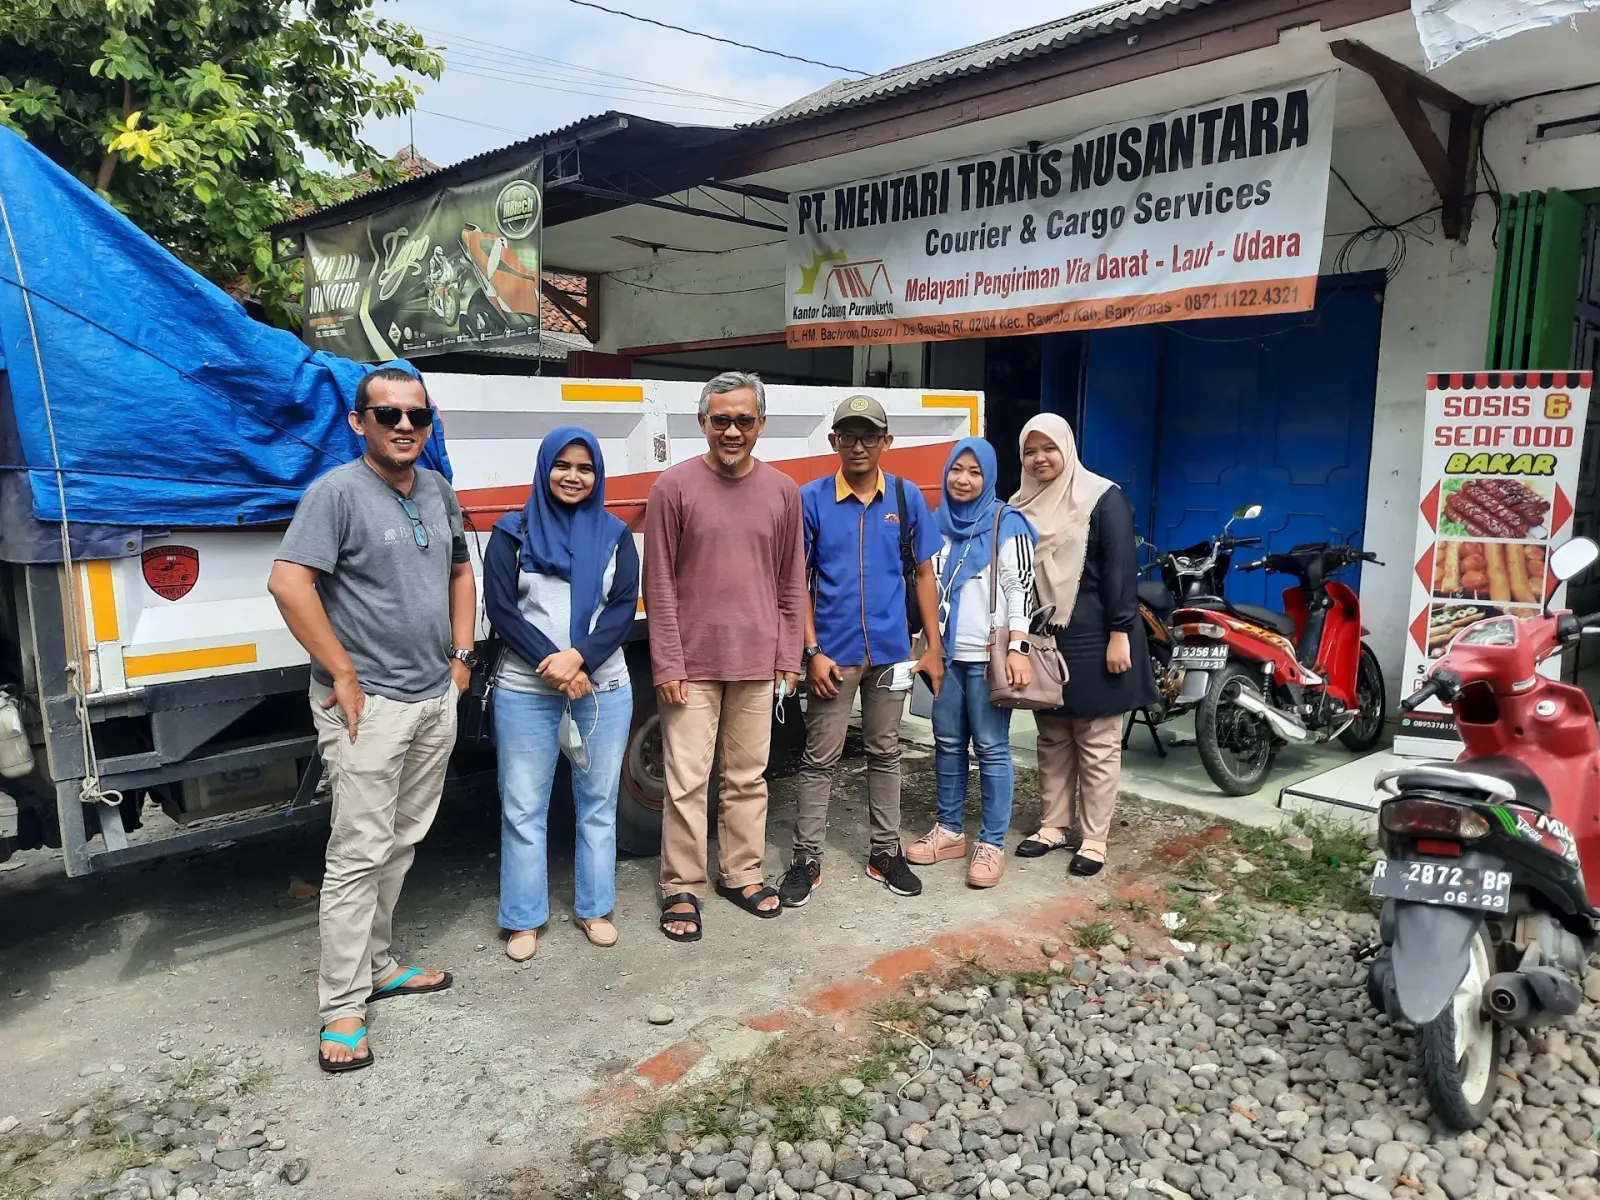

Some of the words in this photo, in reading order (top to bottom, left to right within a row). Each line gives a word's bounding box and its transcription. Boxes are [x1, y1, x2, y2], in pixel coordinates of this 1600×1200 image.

[798, 191, 828, 236] PT.
[833, 168, 951, 232] MENTARI
[957, 149, 1063, 212] TRANS
[1069, 88, 1310, 193] NUSANTARA
[503, 196, 533, 219] MBtech
[925, 222, 1012, 257] Courier
[1019, 214, 1037, 245] &
[1046, 204, 1126, 239] Cargo
[1133, 179, 1273, 225] Services
[904, 271, 970, 305] Melayani
[973, 265, 1060, 299] Pengiriman
[1065, 257, 1092, 285] Via
[1096, 249, 1149, 281] Darat
[1171, 240, 1215, 274] Laut
[1232, 229, 1301, 263] Udara
[792, 305, 820, 321] Kantor
[821, 303, 847, 320] Cabang
[848, 300, 894, 317] Purwokerto
[801, 328, 818, 341] HM.
[860, 325, 892, 339] Dusun
[917, 320, 951, 336] Rawalo
[968, 316, 997, 332] 02/04
[999, 314, 1025, 330] Kec.
[1026, 311, 1070, 329] Rawalo
[1104, 300, 1173, 321] Banyumas
[1183, 285, 1301, 313] 0821.1122.4321
[1443, 395, 1531, 418] SOSIS
[1543, 392, 1573, 420] &
[1434, 425, 1574, 448] SEAFOOD
[1444, 452, 1558, 476] BAKAR
[1172, 646, 1180, 658] B
[1210, 646, 1228, 658] AH
[1373, 859, 1388, 878] R
[1408, 863, 1464, 887] 2872
[1482, 870, 1511, 891] BP
